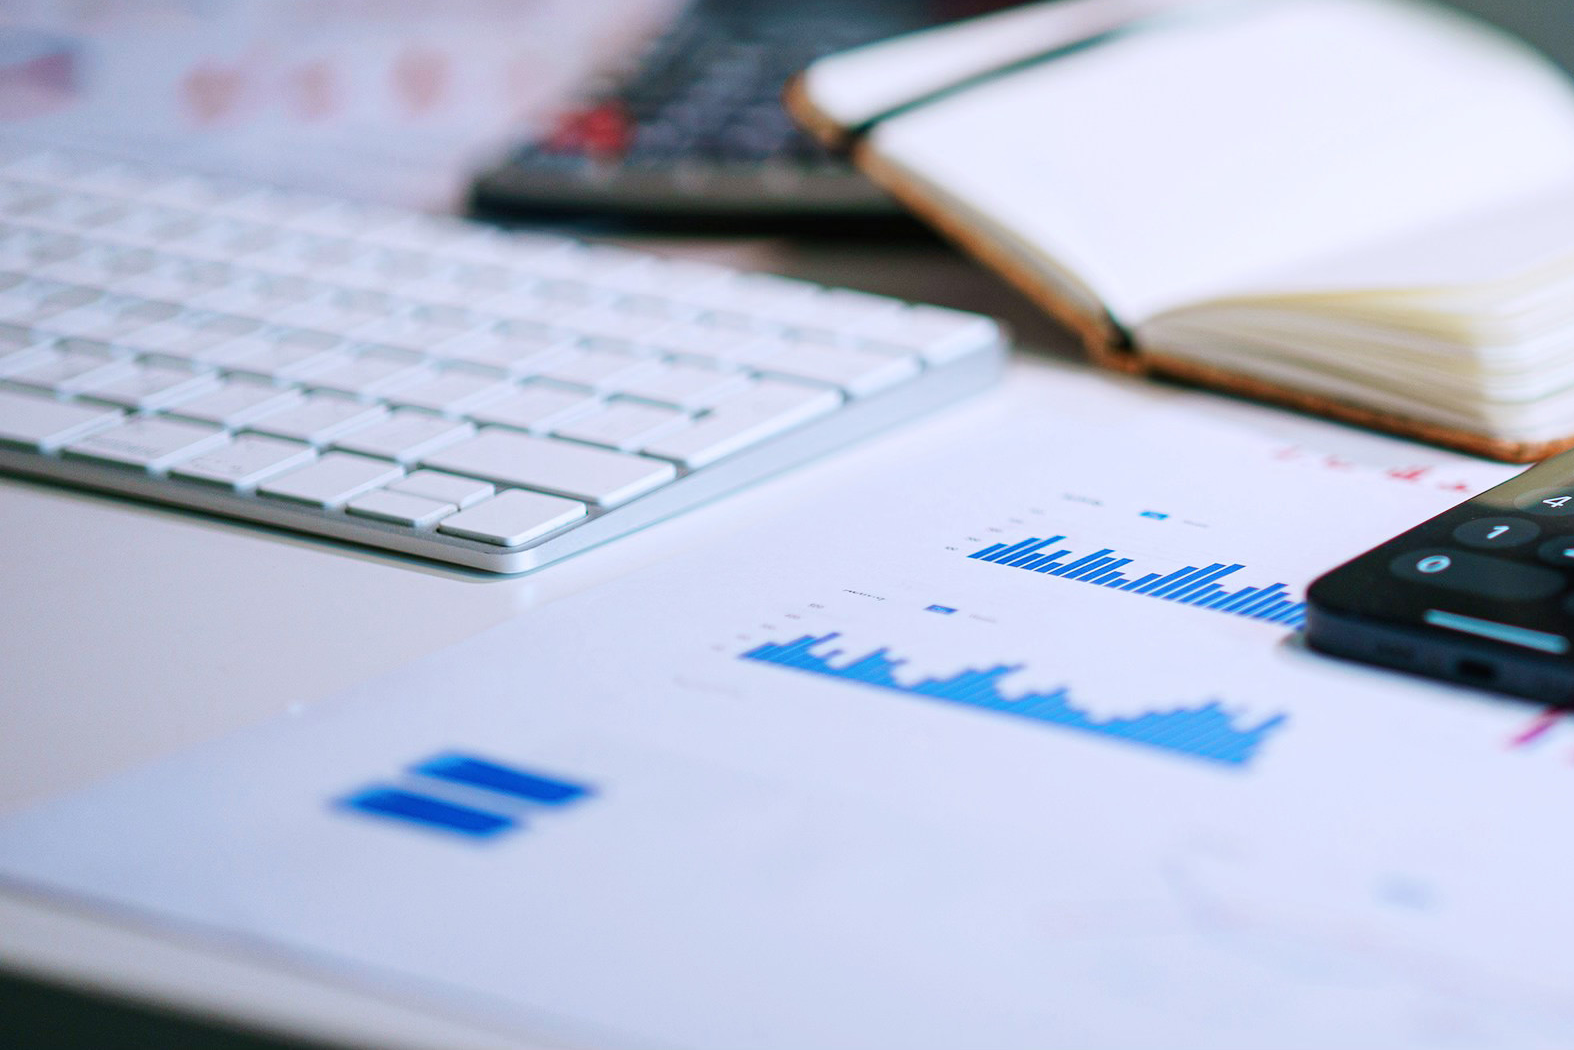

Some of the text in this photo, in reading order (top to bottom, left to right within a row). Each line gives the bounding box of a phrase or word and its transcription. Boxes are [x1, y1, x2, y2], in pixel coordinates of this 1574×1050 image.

[1542, 495, 1573, 508] 4
[1486, 524, 1510, 540] 1
[1416, 555, 1451, 573] 0
